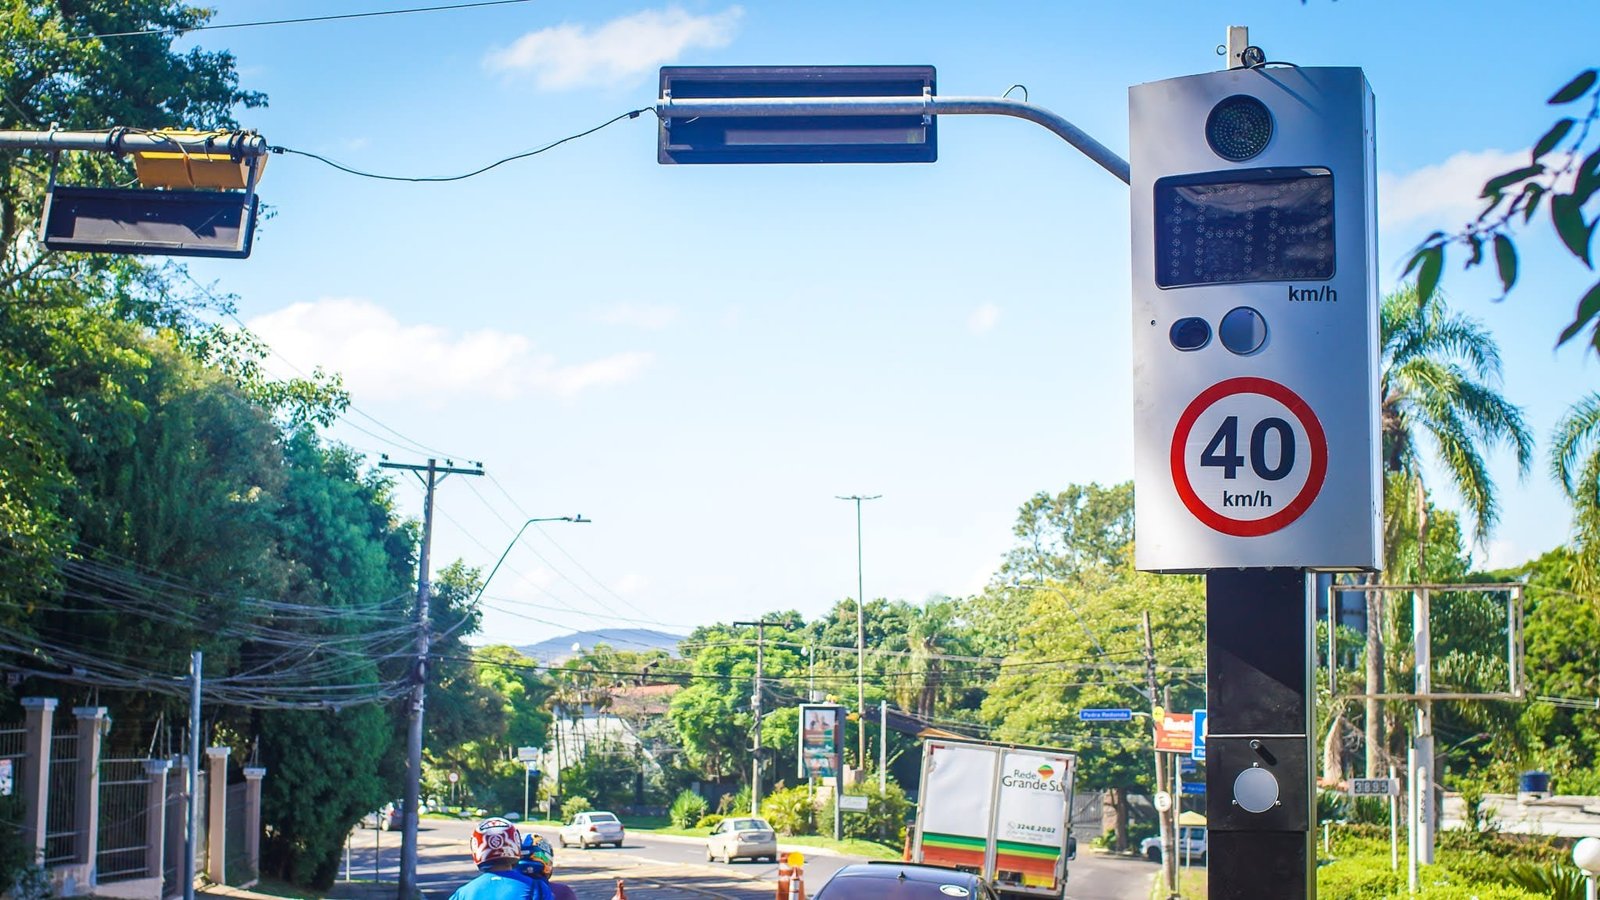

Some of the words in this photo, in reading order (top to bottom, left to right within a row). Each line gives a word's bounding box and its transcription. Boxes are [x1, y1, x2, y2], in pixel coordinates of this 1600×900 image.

[1288, 285, 1337, 302] km/h
[1200, 415, 1296, 482] 40
[1223, 490, 1272, 507] km/h
[1002, 775, 1048, 791] Grande
[1014, 769, 1037, 780] Rede
